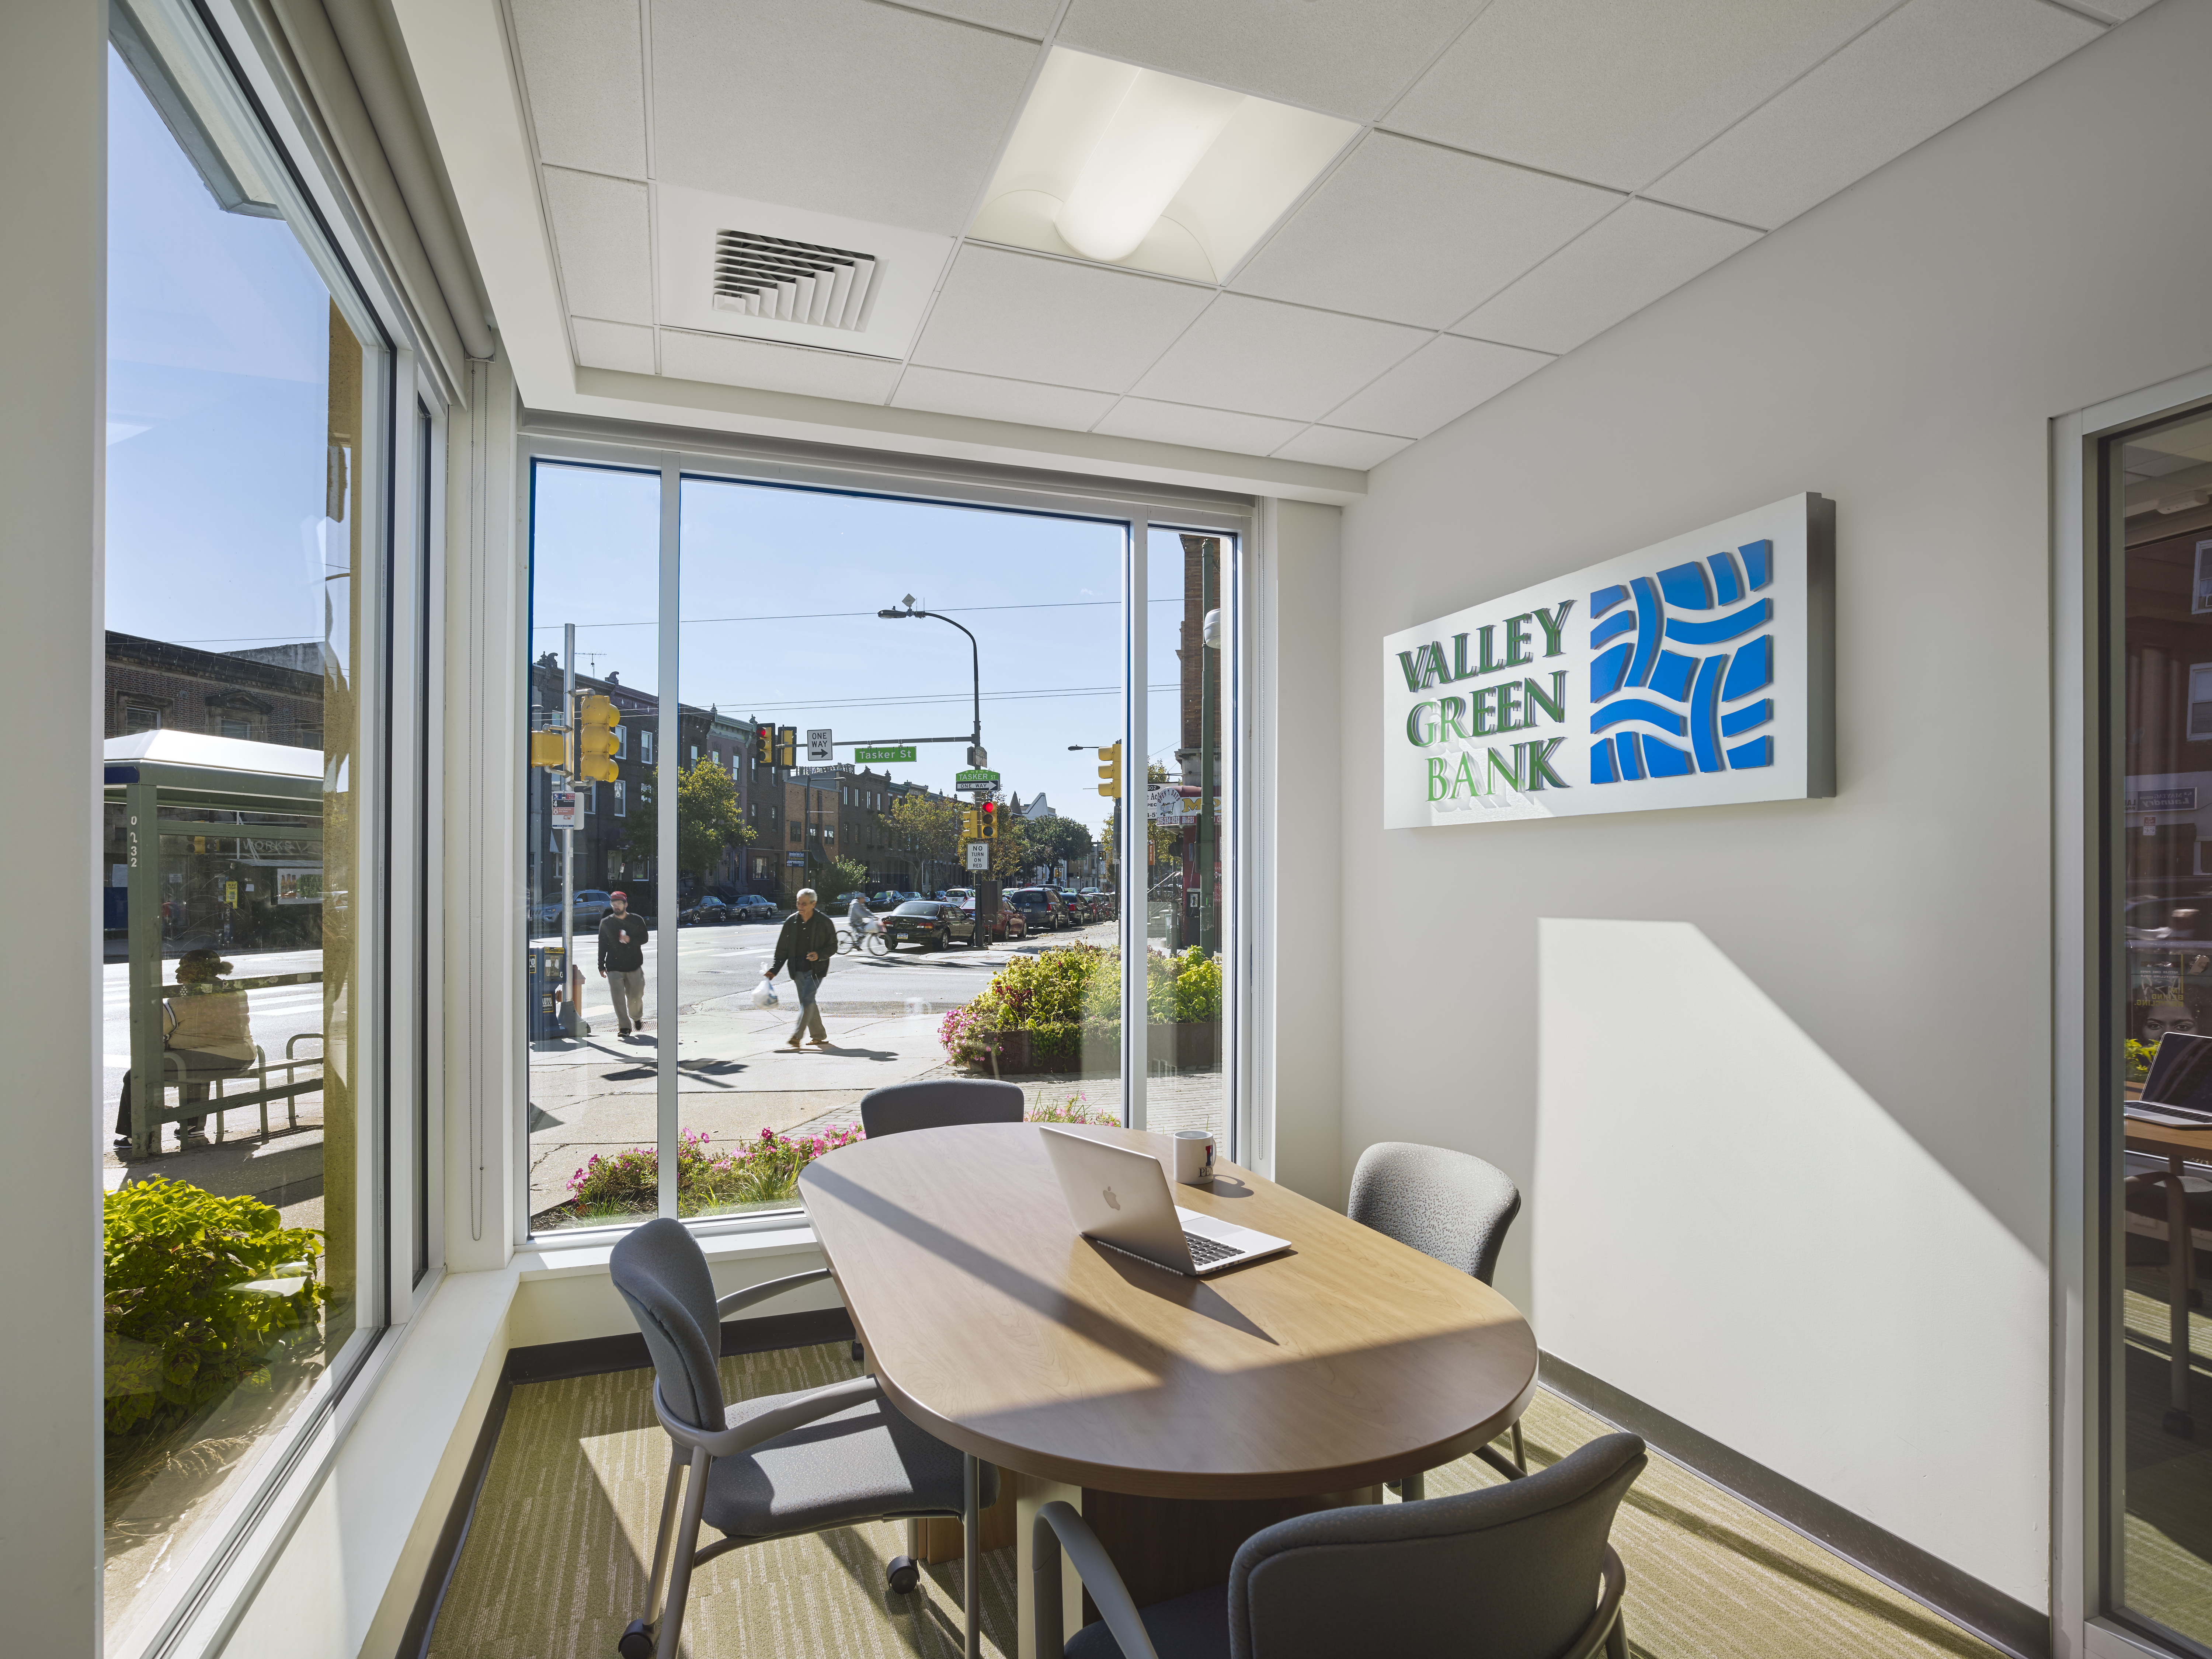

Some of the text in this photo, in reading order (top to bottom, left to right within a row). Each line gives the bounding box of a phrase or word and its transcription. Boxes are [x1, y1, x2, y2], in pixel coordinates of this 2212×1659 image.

[1396, 599, 1576, 692] VALLEY
[1406, 670, 1567, 747] GREEN
[859, 751, 895, 759] Tasker
[1425, 737, 1572, 802] BANK
[1158, 791, 1166, 803] OPEN
[1171, 790, 1180, 802] DAYS
[243, 841, 295, 850] WORKS
[1205, 1145, 1213, 1166] P
